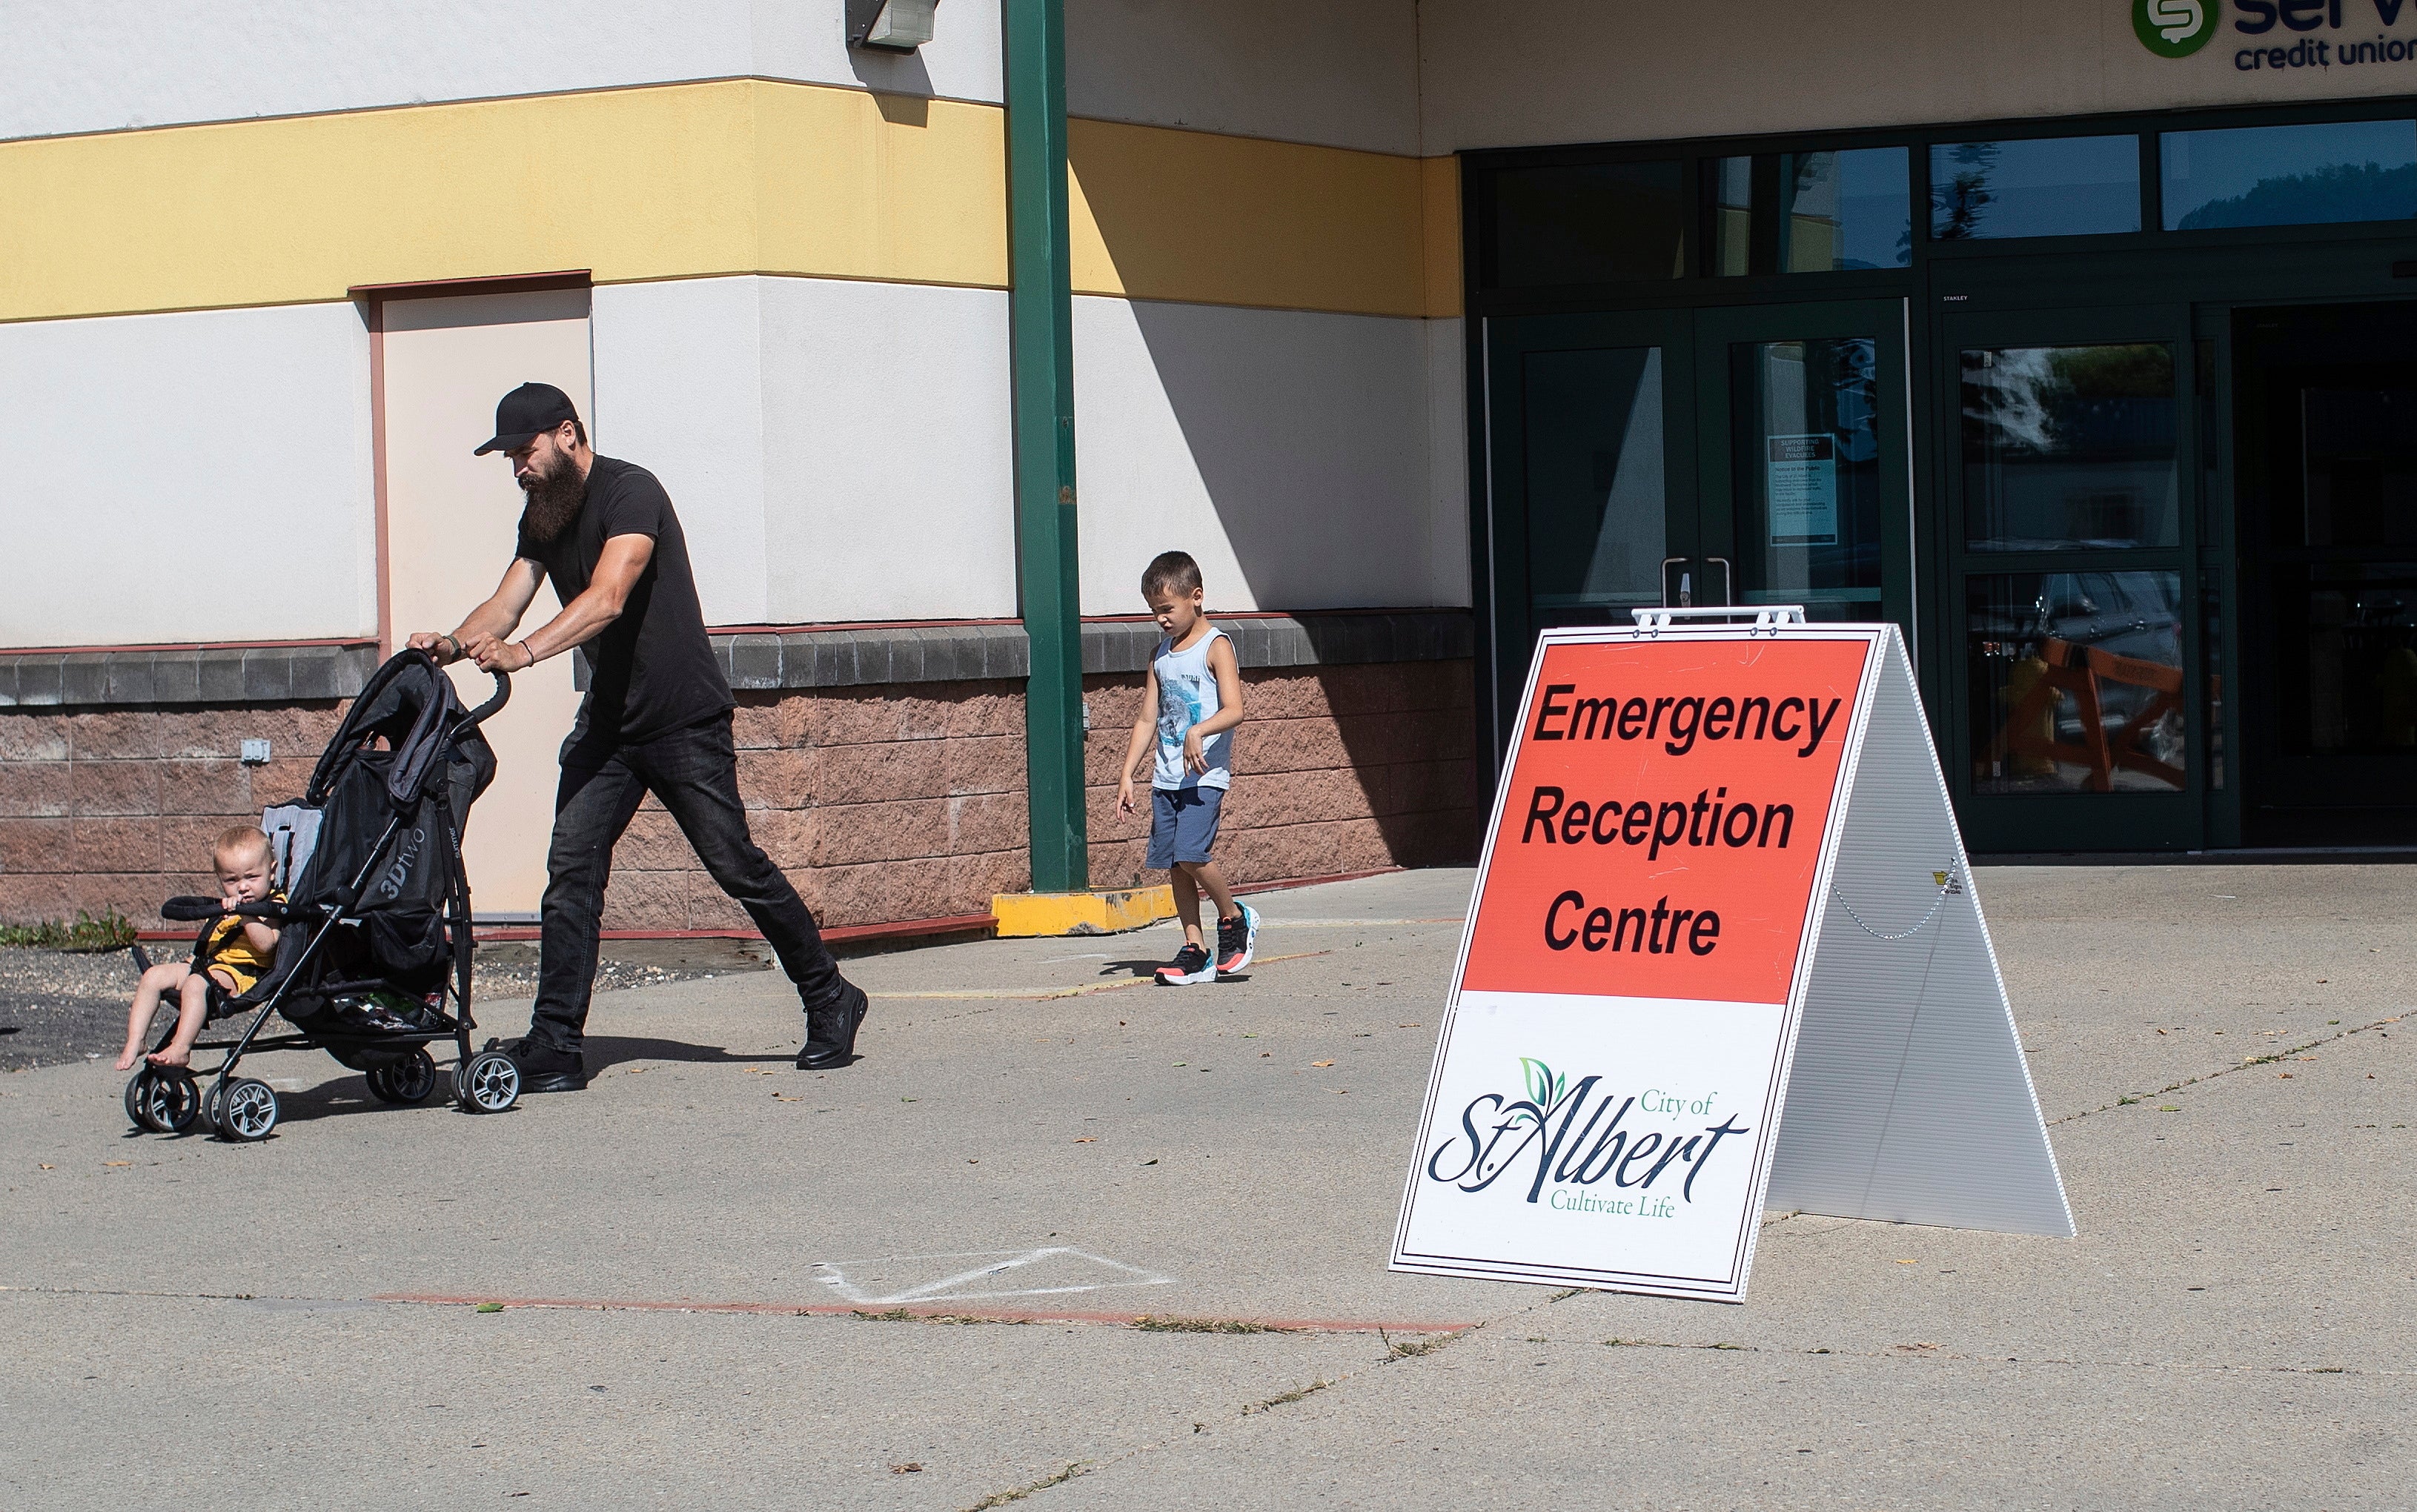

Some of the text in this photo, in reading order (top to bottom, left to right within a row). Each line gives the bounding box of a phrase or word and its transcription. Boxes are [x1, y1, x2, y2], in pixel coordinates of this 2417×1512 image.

[2235, 0, 2417, 34] serv
[2235, 34, 2417, 70] credit union
[1533, 684, 1842, 757] Emergency
[449, 826, 461, 859] summer
[1522, 786, 1794, 861] Reception
[380, 828, 425, 900] 3Dtwo
[1544, 890, 1720, 956] Centre
[1641, 1089, 1718, 1121] City of
[1428, 1075, 1750, 1204] St. Albert
[1551, 1190, 1675, 1219] Cultivate Life
